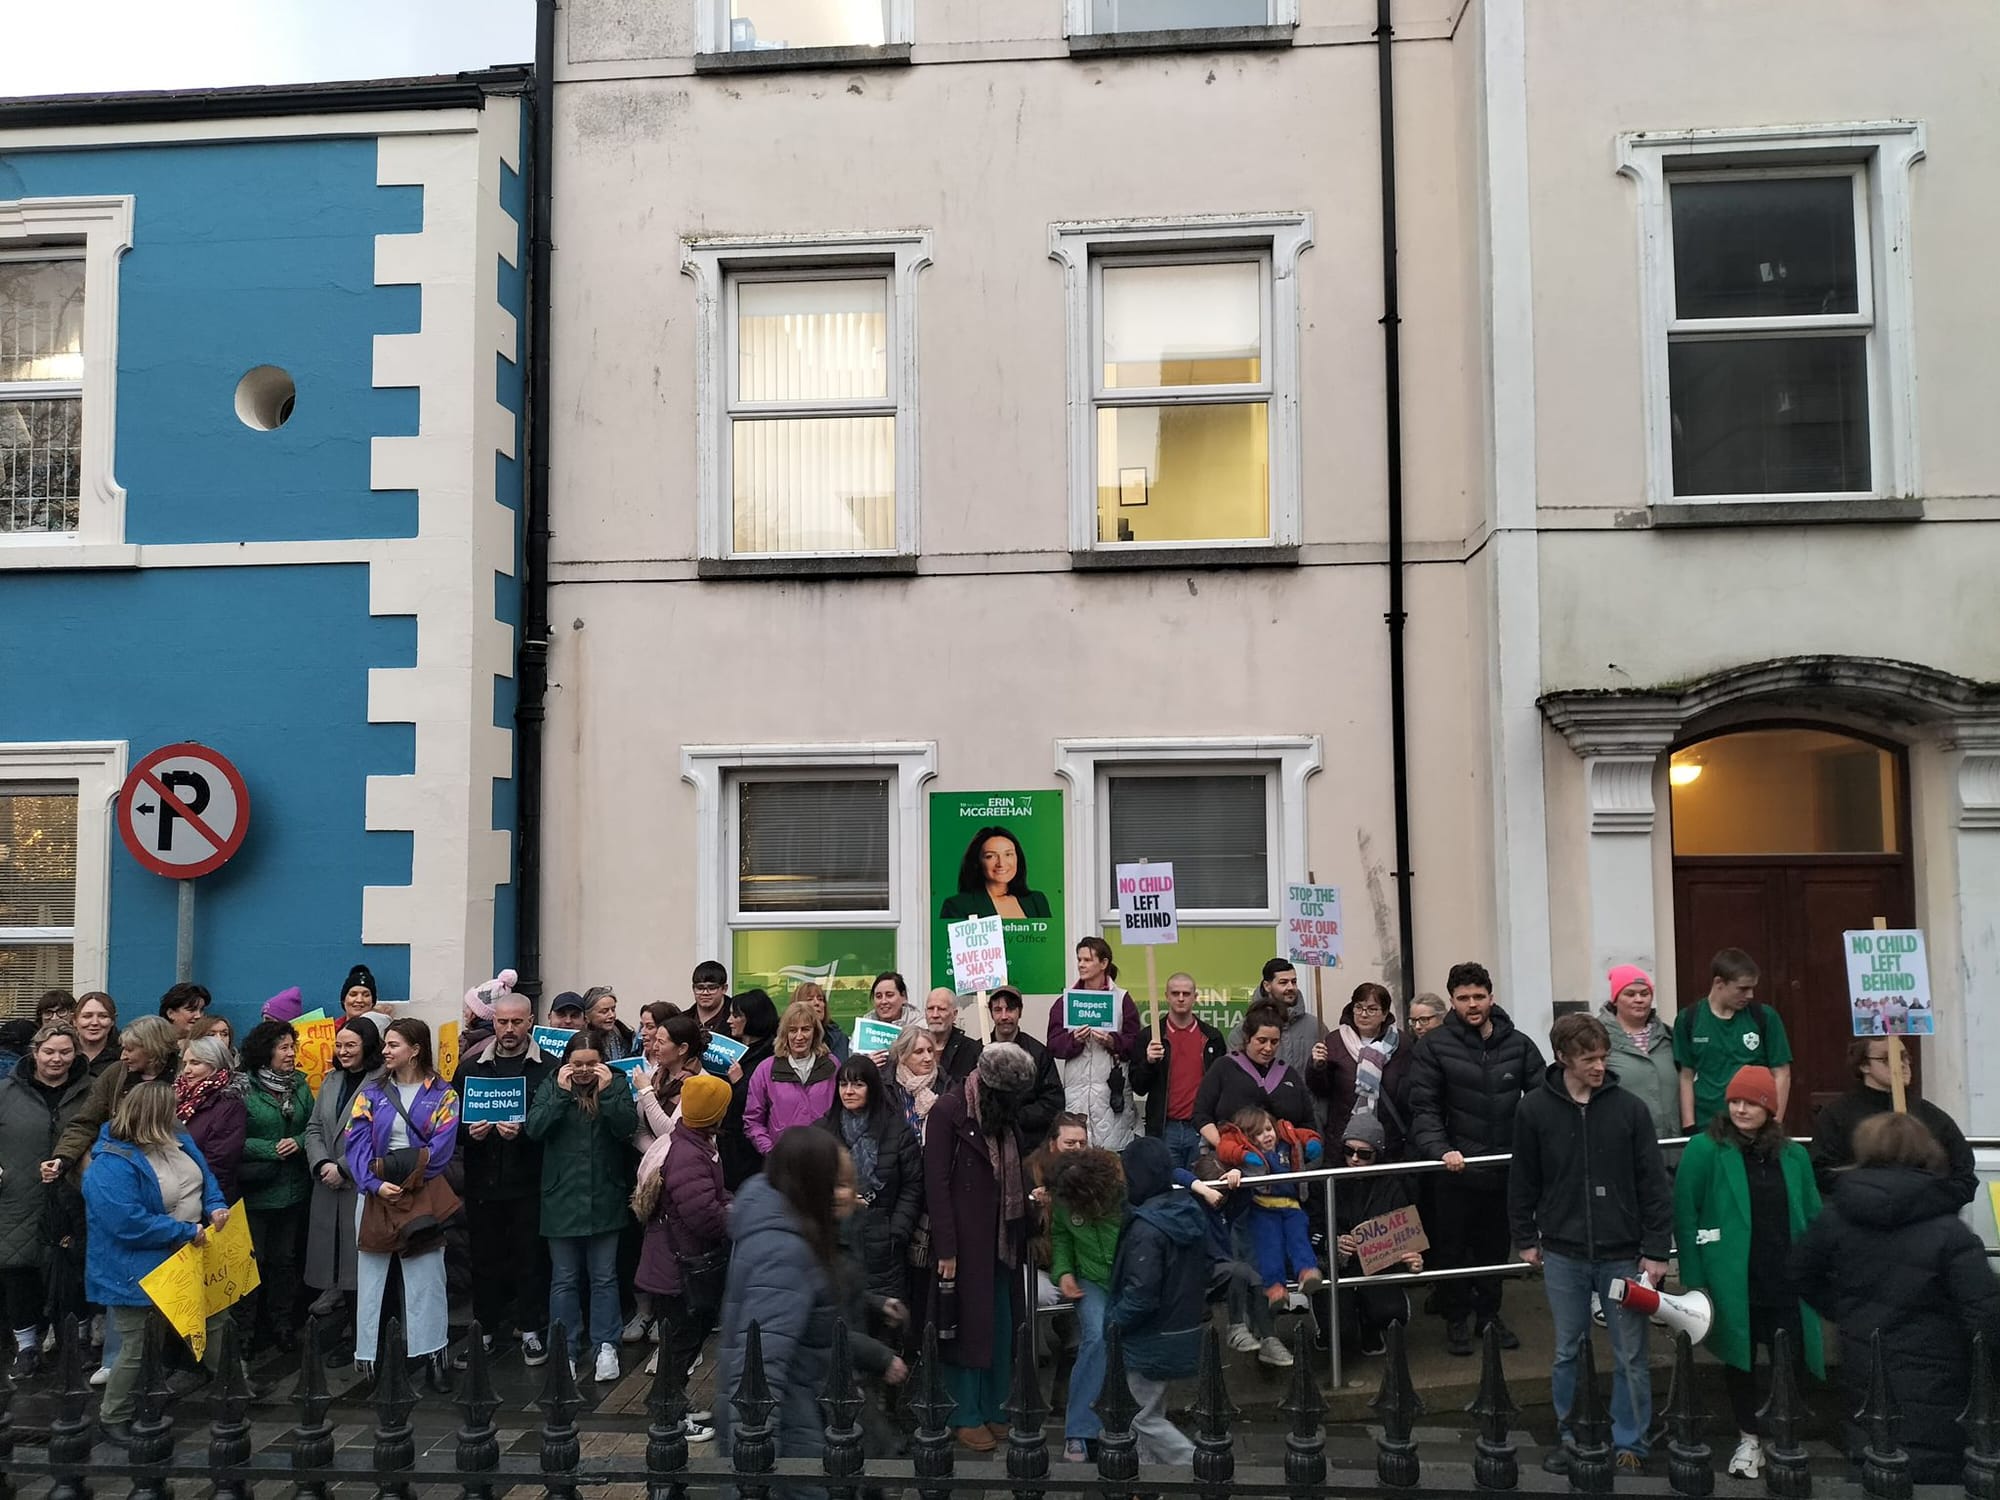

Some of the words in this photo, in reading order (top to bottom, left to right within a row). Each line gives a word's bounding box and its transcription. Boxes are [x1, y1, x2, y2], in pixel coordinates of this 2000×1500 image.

[988, 797, 1015, 807] ERIN
[959, 807, 1033, 817] MCGREEHAN
[1119, 878, 1136, 893] NO
[1139, 876, 1173, 892] CHILD
[1289, 886, 1312, 902] STOP
[1314, 888, 1335, 903] THE
[1133, 895, 1160, 911] LEFT
[1300, 902, 1324, 917] CUTS
[1002, 922, 1030, 932] ehan
[1032, 922, 1048, 932] TD
[1125, 912, 1171, 929] BEHIND
[1289, 918, 1313, 934] SAVE
[1315, 920, 1339, 935] OUR
[955, 922, 978, 938] STOP
[980, 920, 998, 934] THE
[966, 934, 989, 948] CUTS
[1851, 936, 1873, 954] NO
[1876, 935, 1918, 953] CHILD
[956, 950, 979, 966] SAVE
[981, 947, 1002, 961] OUR
[1871, 954, 1902, 972] LEFT
[1861, 973, 1916, 991] BEHIND
[1072, 1000, 1107, 1009] Respect
[1078, 1009, 1102, 1018] SNAs
[707, 1042, 736, 1057] spect
[702, 1052, 724, 1065] SNAs
[467, 1087, 483, 1097] Our
[484, 1088, 521, 1097] schools
[468, 1100, 490, 1108] need
[491, 1100, 519, 1108] SNAs
[1388, 1211, 1408, 1230] ARE
